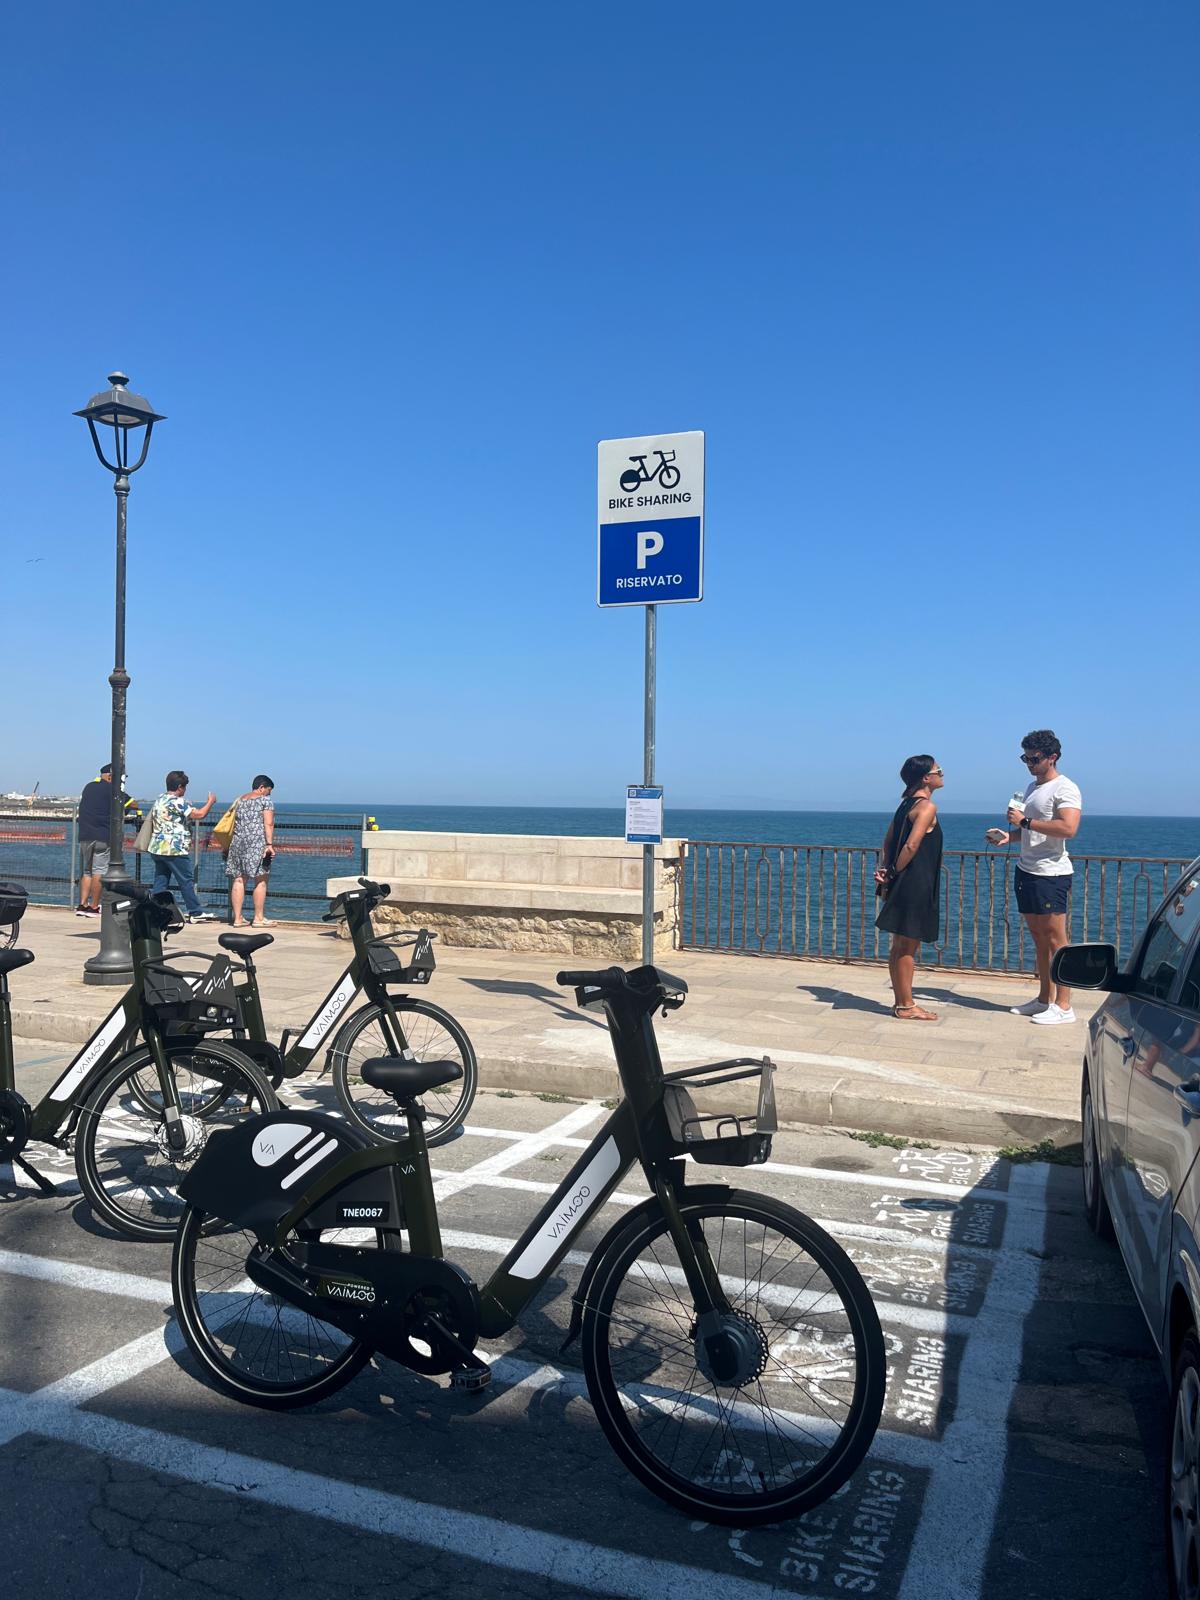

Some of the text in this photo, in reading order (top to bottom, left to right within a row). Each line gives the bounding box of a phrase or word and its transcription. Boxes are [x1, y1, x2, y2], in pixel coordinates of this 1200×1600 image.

[609, 492, 692, 509] BIKE SHARING
[636, 531, 665, 570] P
[616, 574, 683, 588] RISERVATO
[213, 976, 226, 990] VA
[312, 992, 346, 1037] VAIMOO
[76, 1038, 106, 1075] VAIMOO
[259, 1142, 276, 1156] VA
[401, 1164, 416, 1175] VA
[342, 1207, 383, 1218] TNE0067
[547, 1185, 591, 1239] VAIMOO
[326, 1285, 376, 1302] VAIMOO
[895, 1336, 946, 1426] SHARING
[832, 1469, 906, 1593] SHARING
